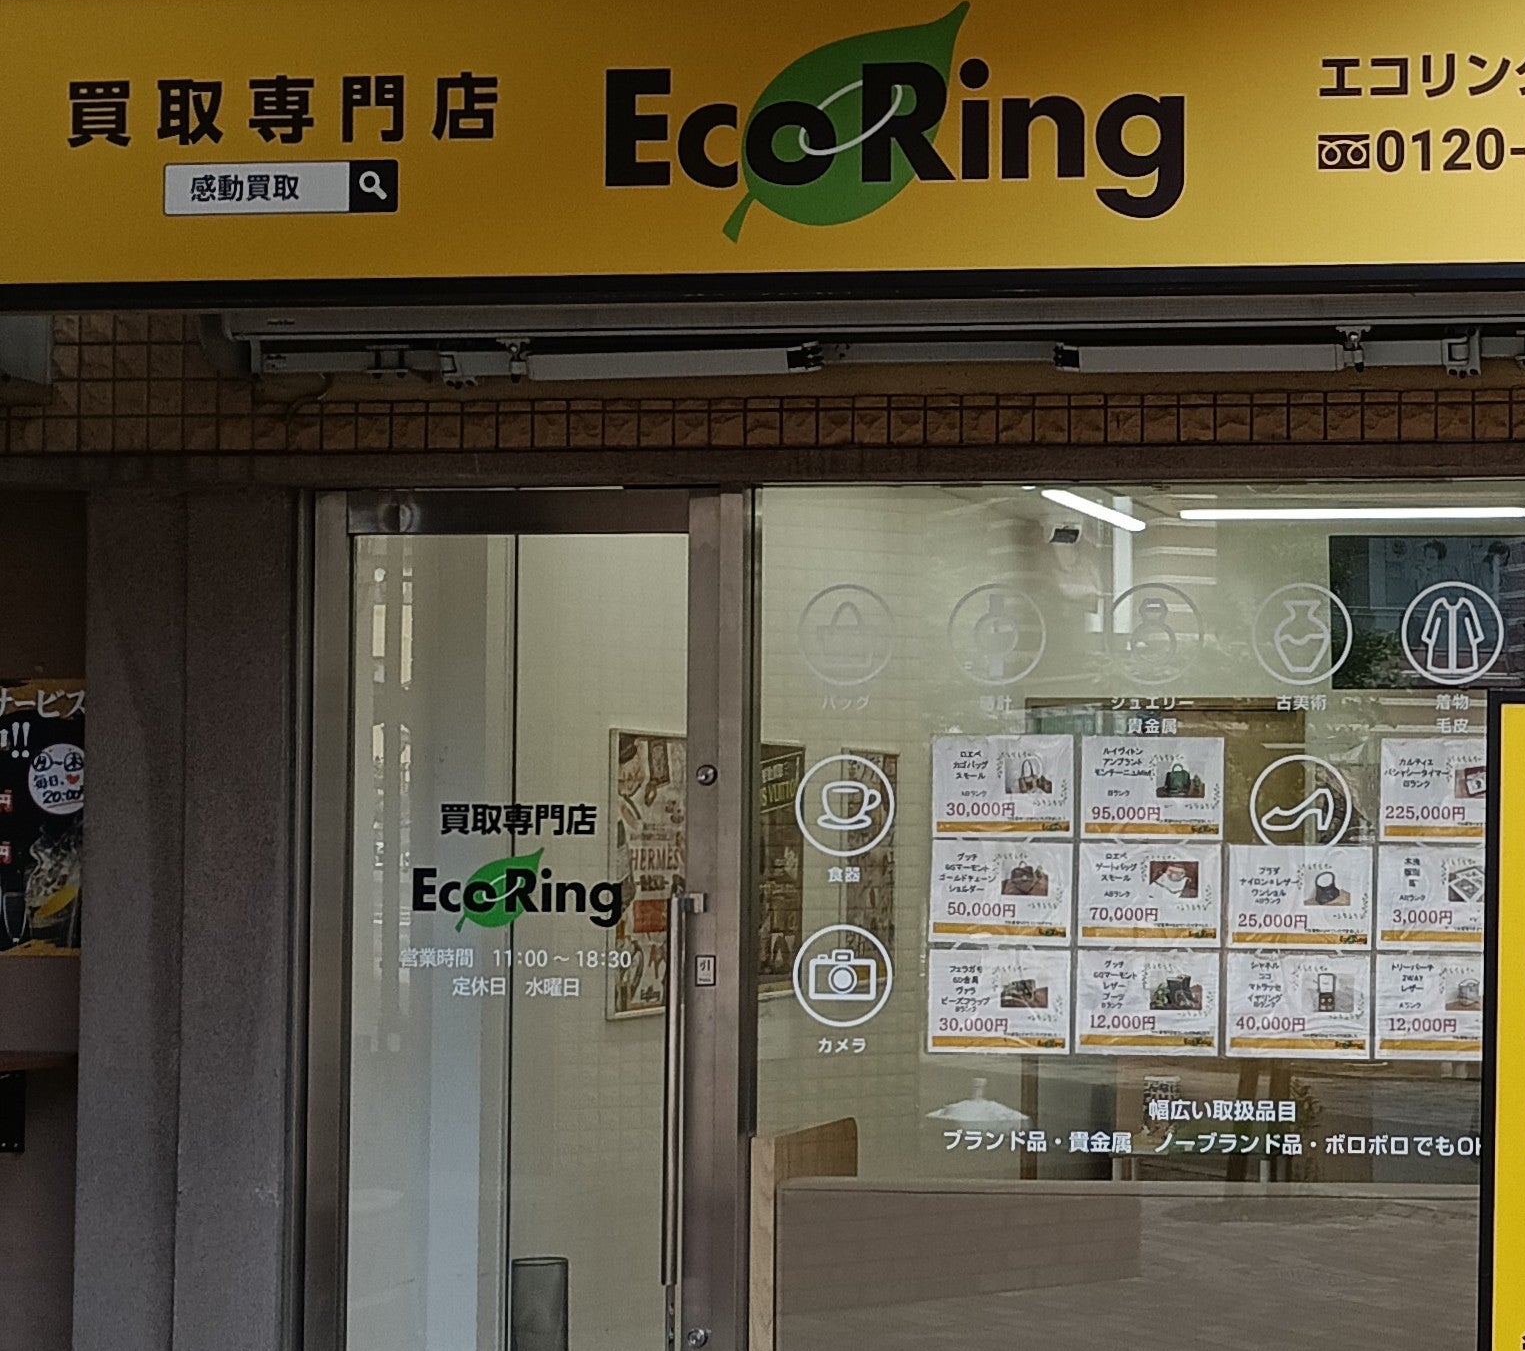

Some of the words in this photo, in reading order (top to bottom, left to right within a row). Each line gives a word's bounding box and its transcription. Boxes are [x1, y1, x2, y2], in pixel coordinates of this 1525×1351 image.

[68, 72, 499, 147] 買取専門店
[606, 59, 1186, 219] EcoRing
[190, 173, 300, 202] 感動買取
[1277, 694, 1326, 711] 古美術
[1436, 694, 1469, 711] 着物
[1127, 718, 1178, 735] 貴金属
[1436, 717, 1469, 734] 毛皮
[946, 802, 1015, 817] 30,000円
[1092, 806, 1160, 821] 95,000円
[1385, 806, 1465, 821] 225,000円
[441, 804, 597, 835] 買取専門店
[828, 867, 860, 883] 食器
[412, 868, 622, 927] EcoRing
[947, 902, 1016, 918] 50,000円
[1089, 907, 1158, 922] 70,000円
[1392, 909, 1452, 925] 3,000円
[1238, 913, 1308, 929] 25,000円
[452, 977, 506, 996] 定休日
[526, 977, 580, 996] 水曜日
[939, 1017, 1008, 1032] 30,000円
[1090, 1015, 1156, 1030] 12,000円
[1236, 1016, 1306, 1031] 40,000円
[1388, 1017, 1457, 1033] 12,000円
[818, 1038, 867, 1053] カメラ
[1148, 1099, 1297, 1122] 幅広い取扱品目
